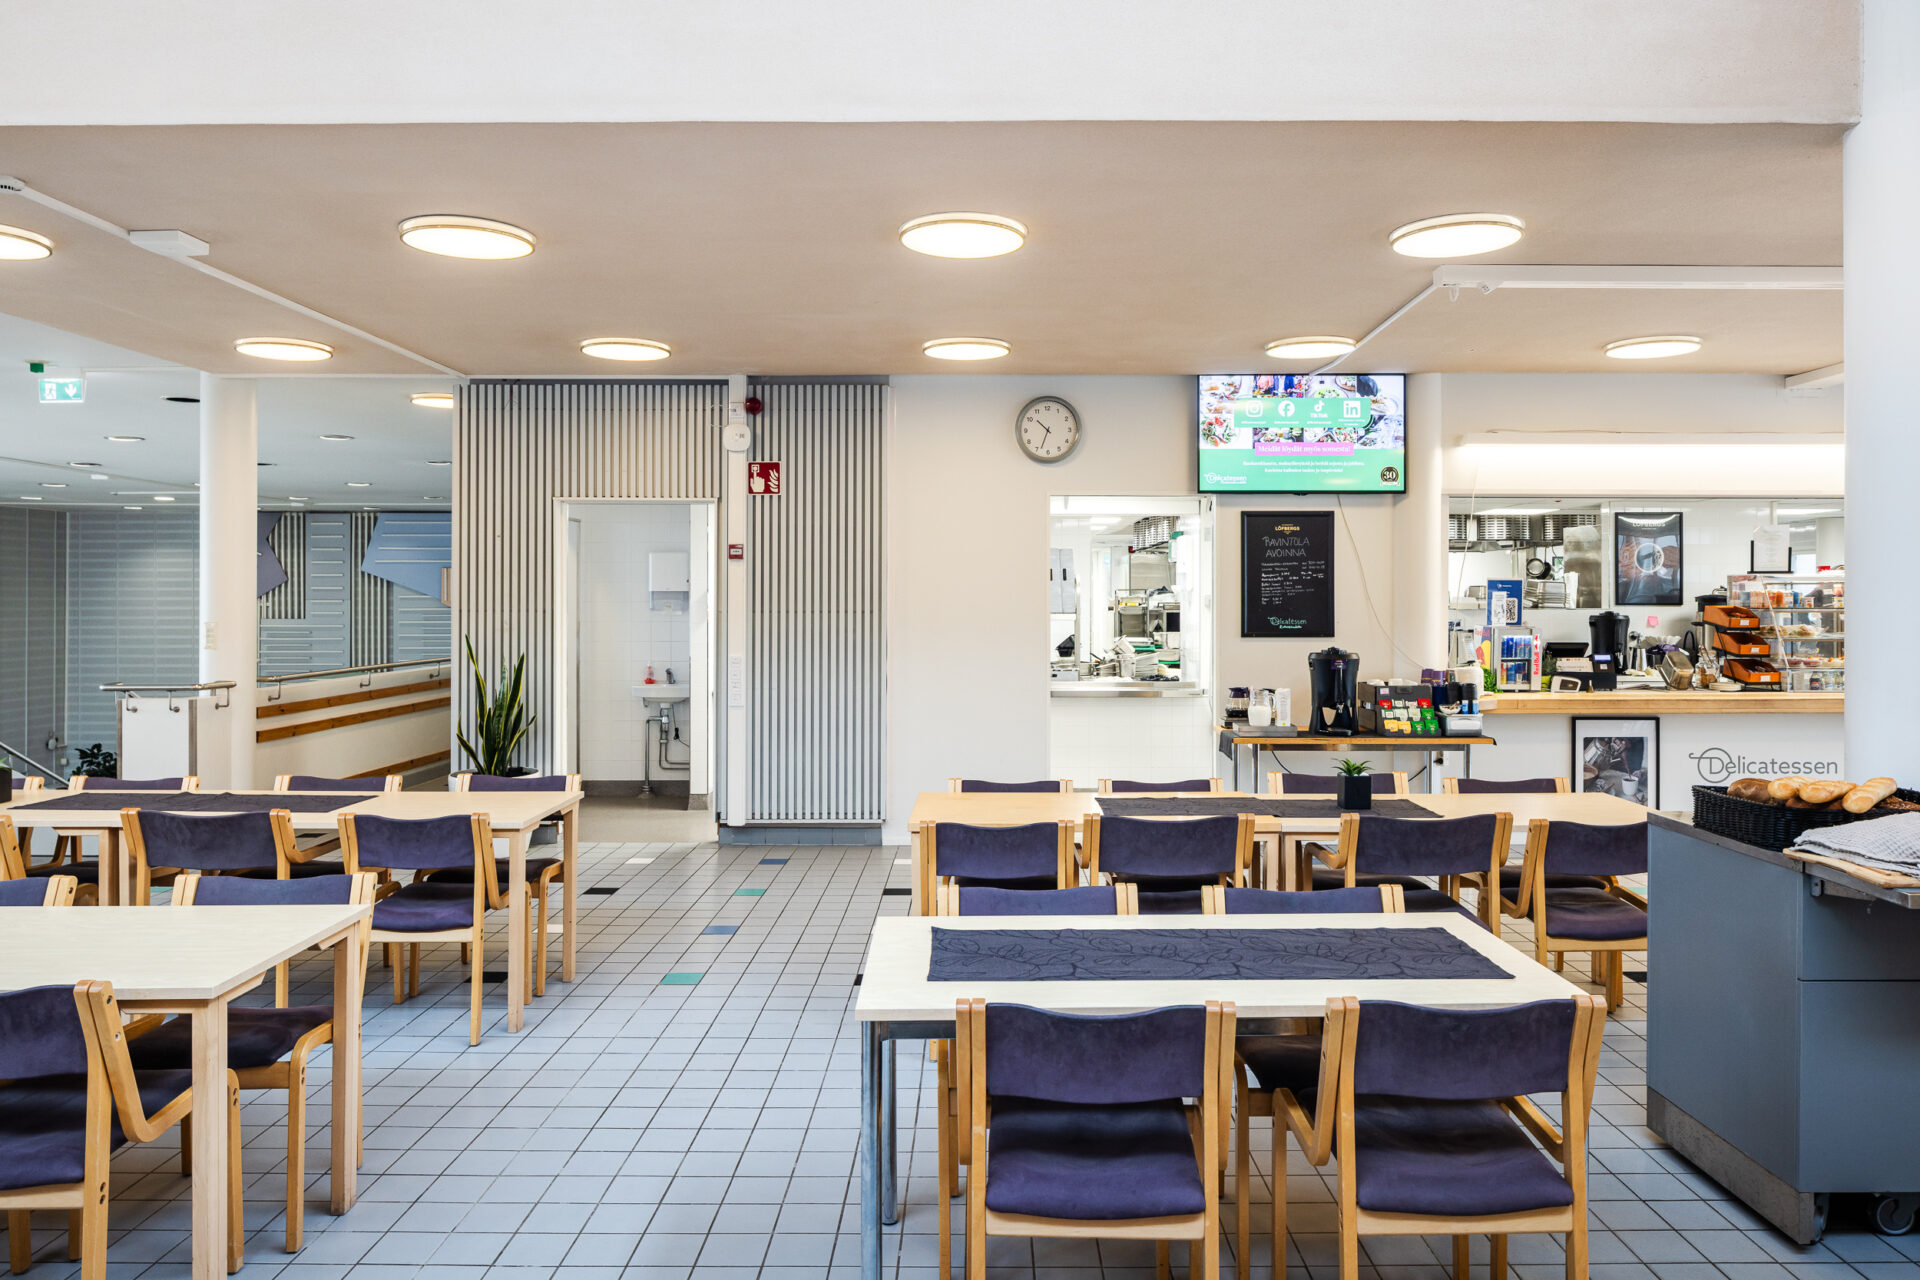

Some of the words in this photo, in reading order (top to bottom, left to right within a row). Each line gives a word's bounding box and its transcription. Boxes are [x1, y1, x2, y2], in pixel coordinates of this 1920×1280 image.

[1383, 470, 1396, 480] 30
[1262, 536, 1310, 547] RAVINTOLA
[1265, 548, 1307, 558] AVOINNA
[1689, 750, 1838, 780] Delicatessen
